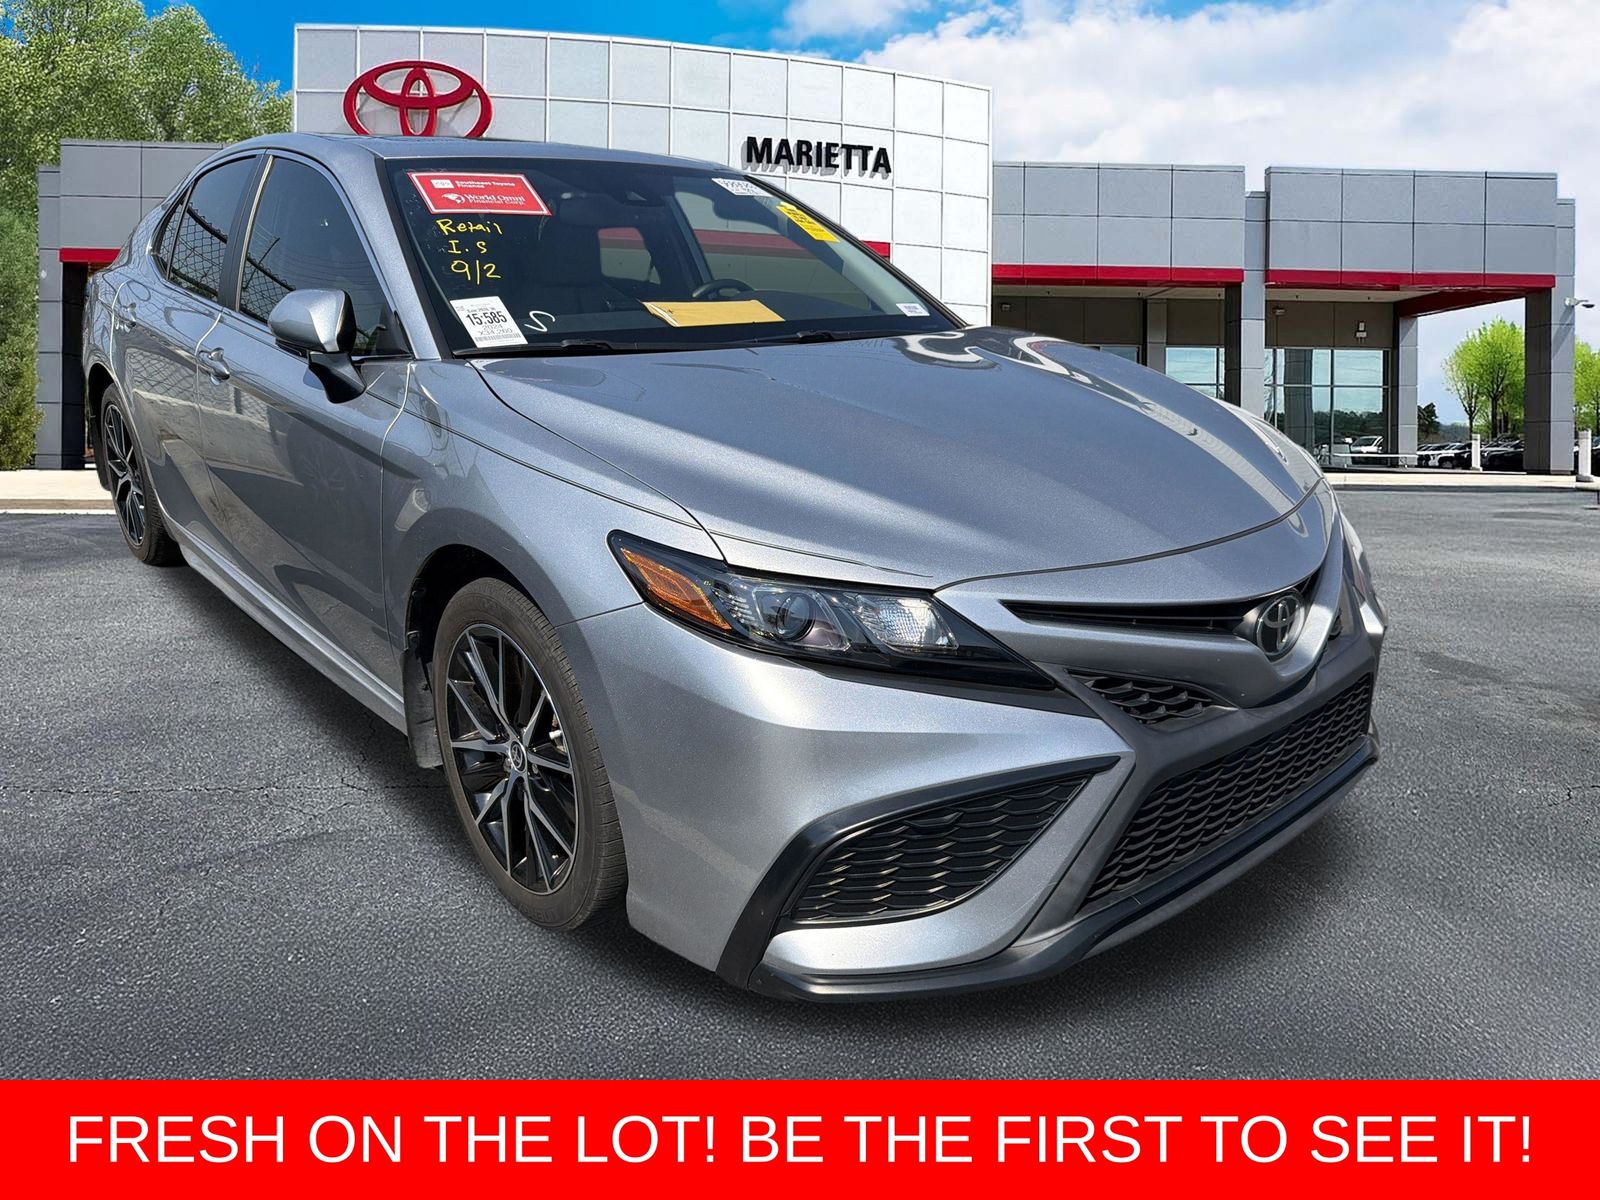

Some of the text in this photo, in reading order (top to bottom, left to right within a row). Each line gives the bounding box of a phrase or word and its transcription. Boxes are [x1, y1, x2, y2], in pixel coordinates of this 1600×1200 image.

[745, 136, 892, 173] MARIETTA
[464, 193, 496, 201] World
[436, 219, 503, 235] Retail
[466, 311, 507, 326] 15:585
